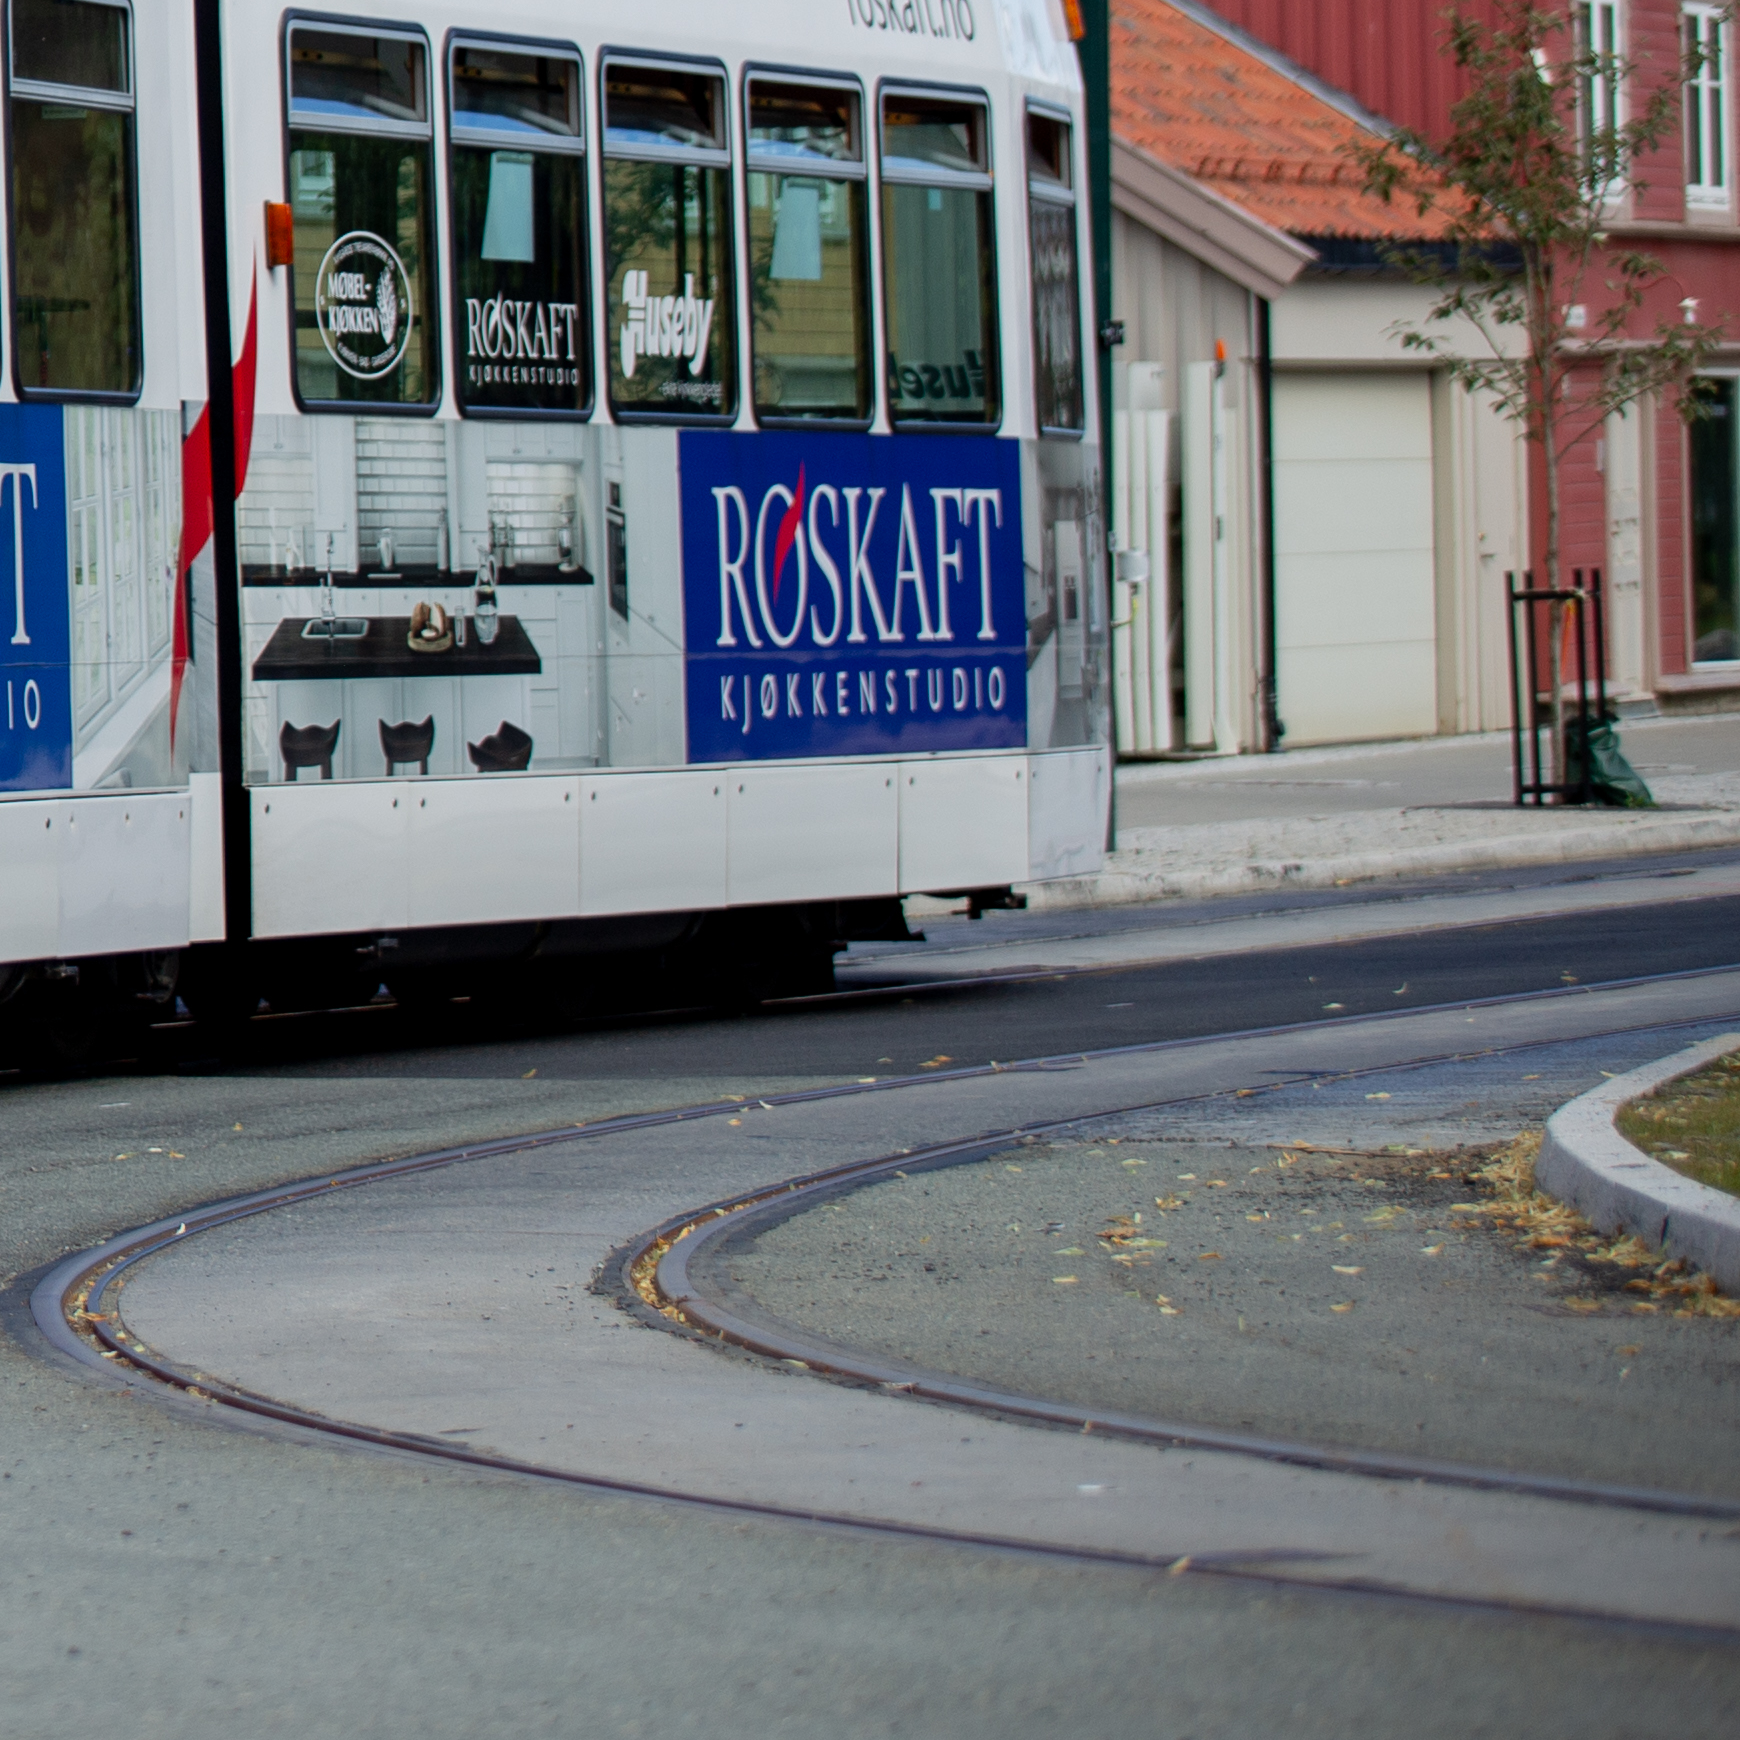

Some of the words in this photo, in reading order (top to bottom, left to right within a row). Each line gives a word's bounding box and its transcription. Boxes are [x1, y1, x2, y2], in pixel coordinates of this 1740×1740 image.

[327, 305, 380, 337] KJØKKEN
[464, 290, 579, 361] RØSKAFT
[619, 269, 715, 379] Huseby
[468, 363, 580, 387] KJØKKENSTUDIO
[710, 459, 1004, 649] RØSKAFT
[719, 665, 1007, 735] KJØKKENSTUDIO
